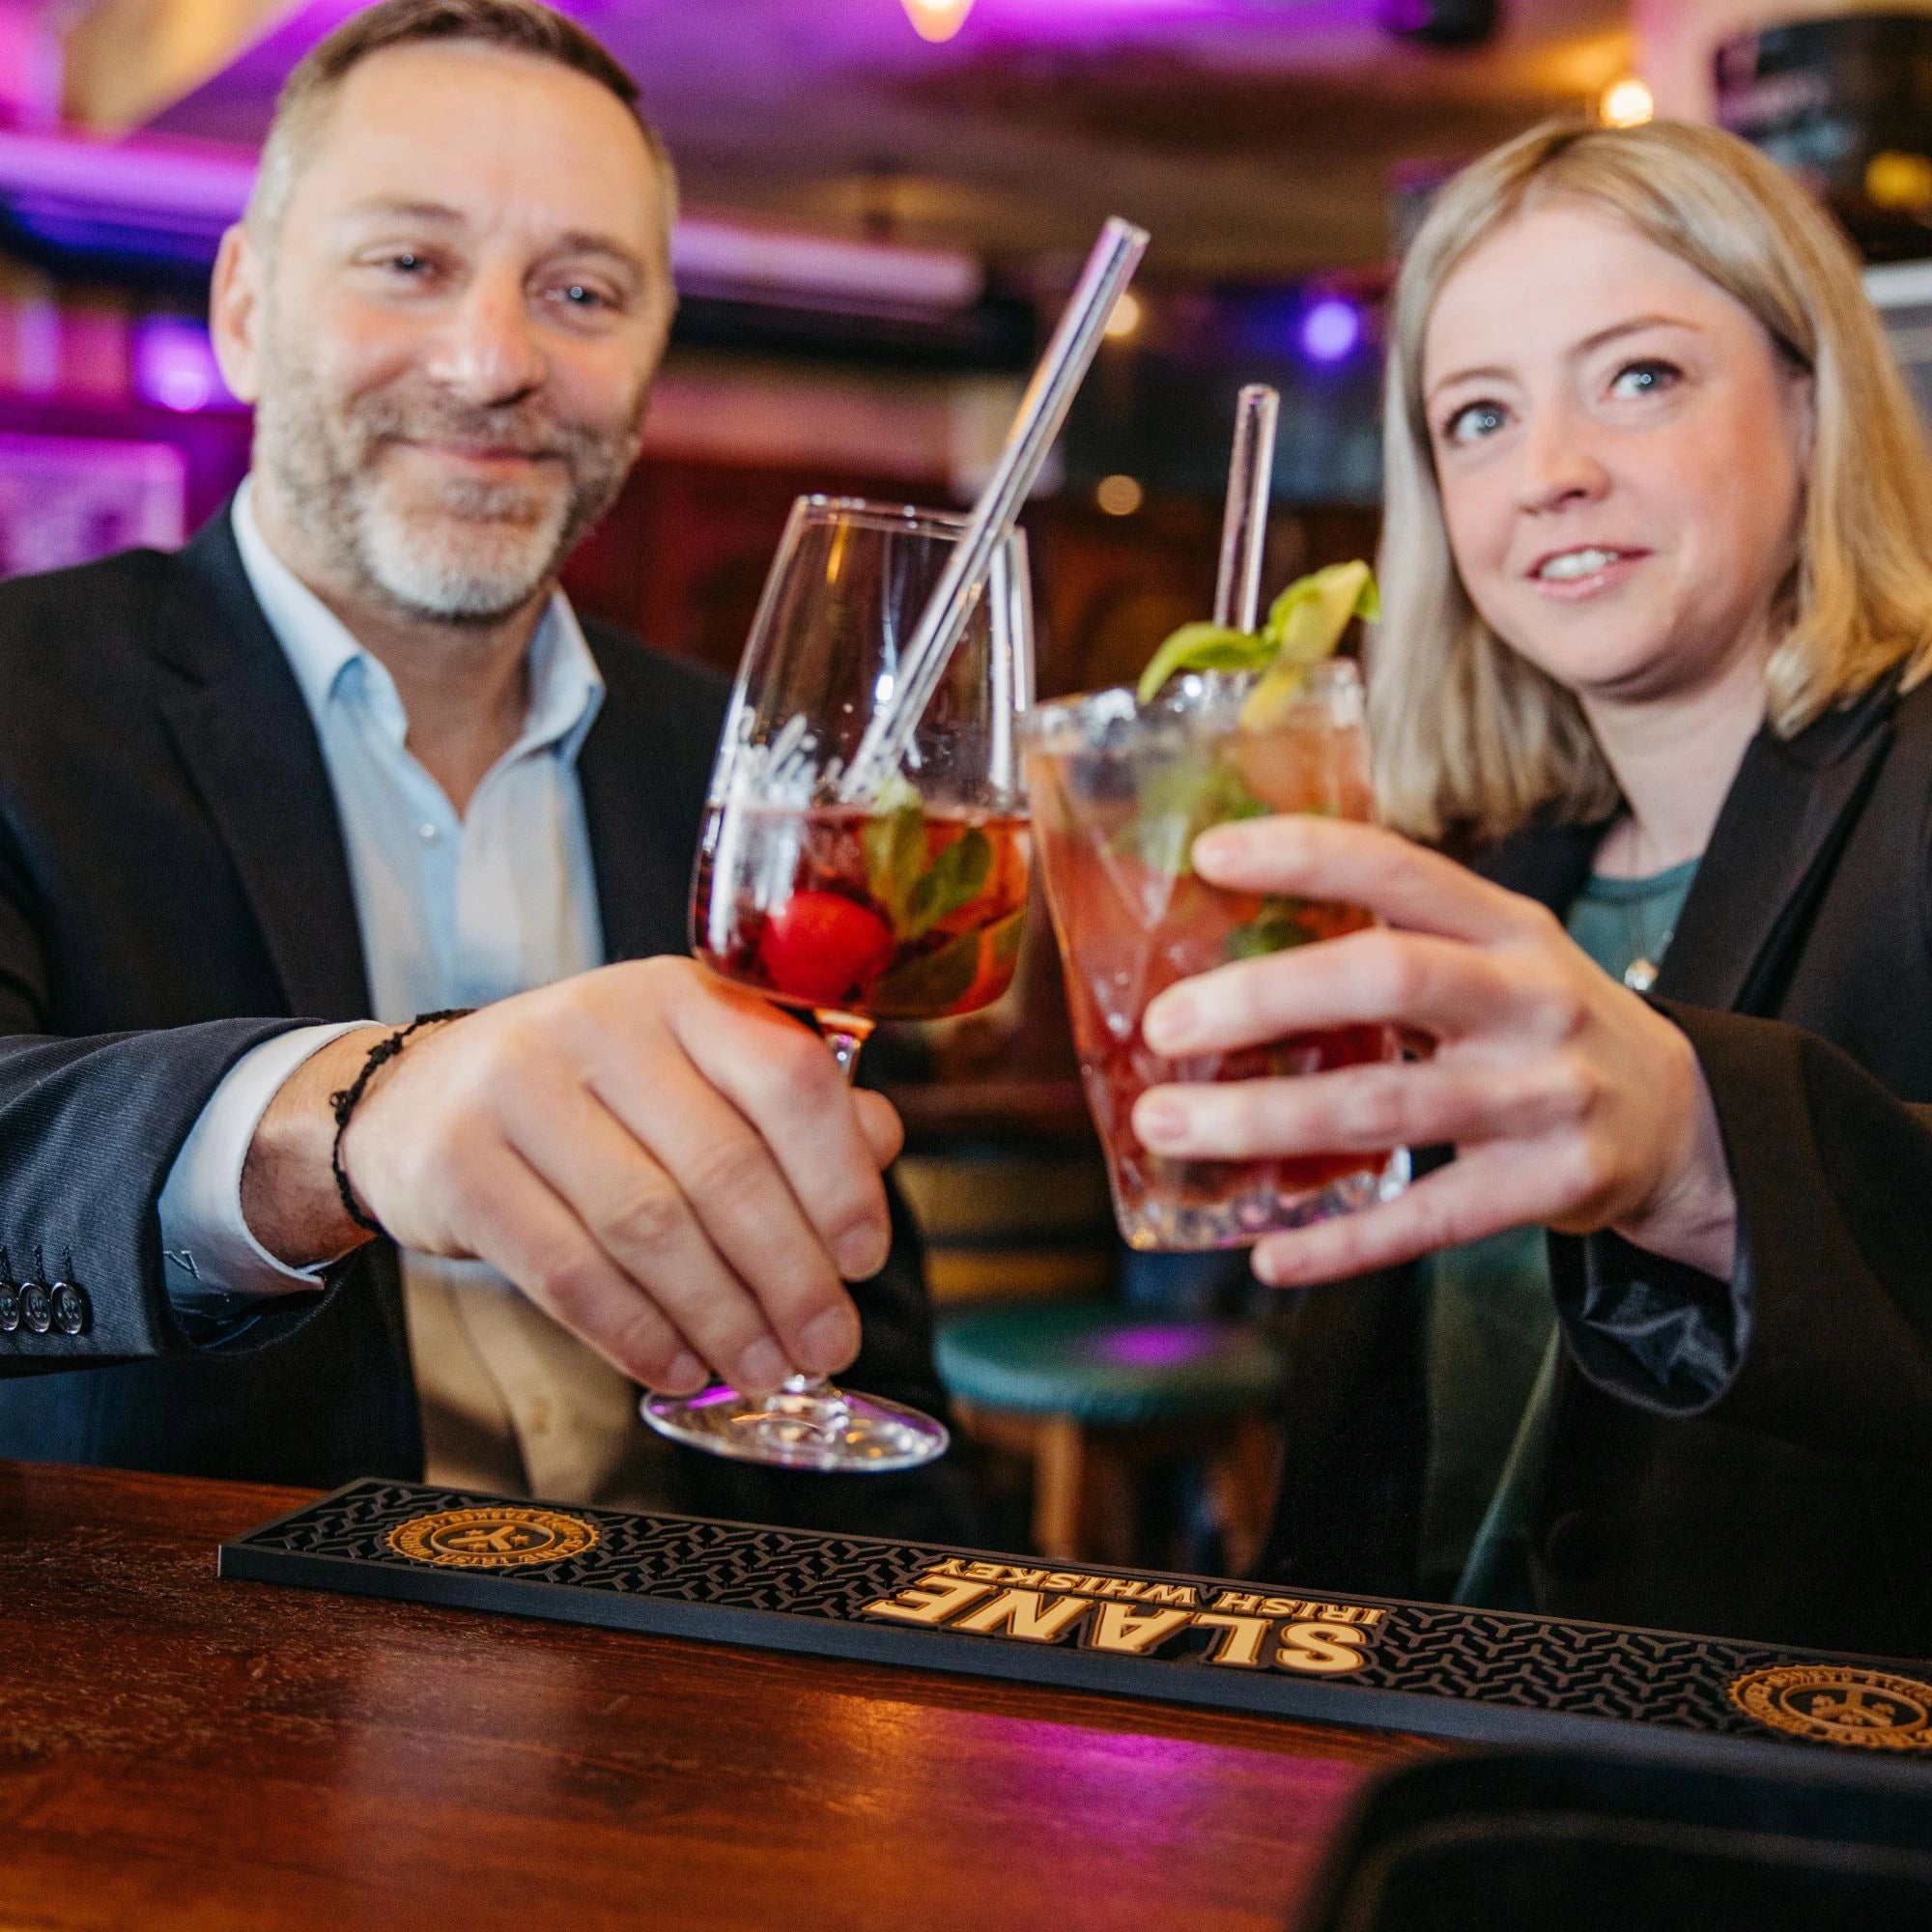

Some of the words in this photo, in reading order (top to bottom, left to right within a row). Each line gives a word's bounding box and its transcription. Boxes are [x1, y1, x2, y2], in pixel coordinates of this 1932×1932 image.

[434, 1553, 509, 1566] IRISH
[922, 1557, 1197, 1608] WHISKEY
[863, 1574, 1368, 1673] SLANE
[1211, 1591, 1388, 1627] IRISH
